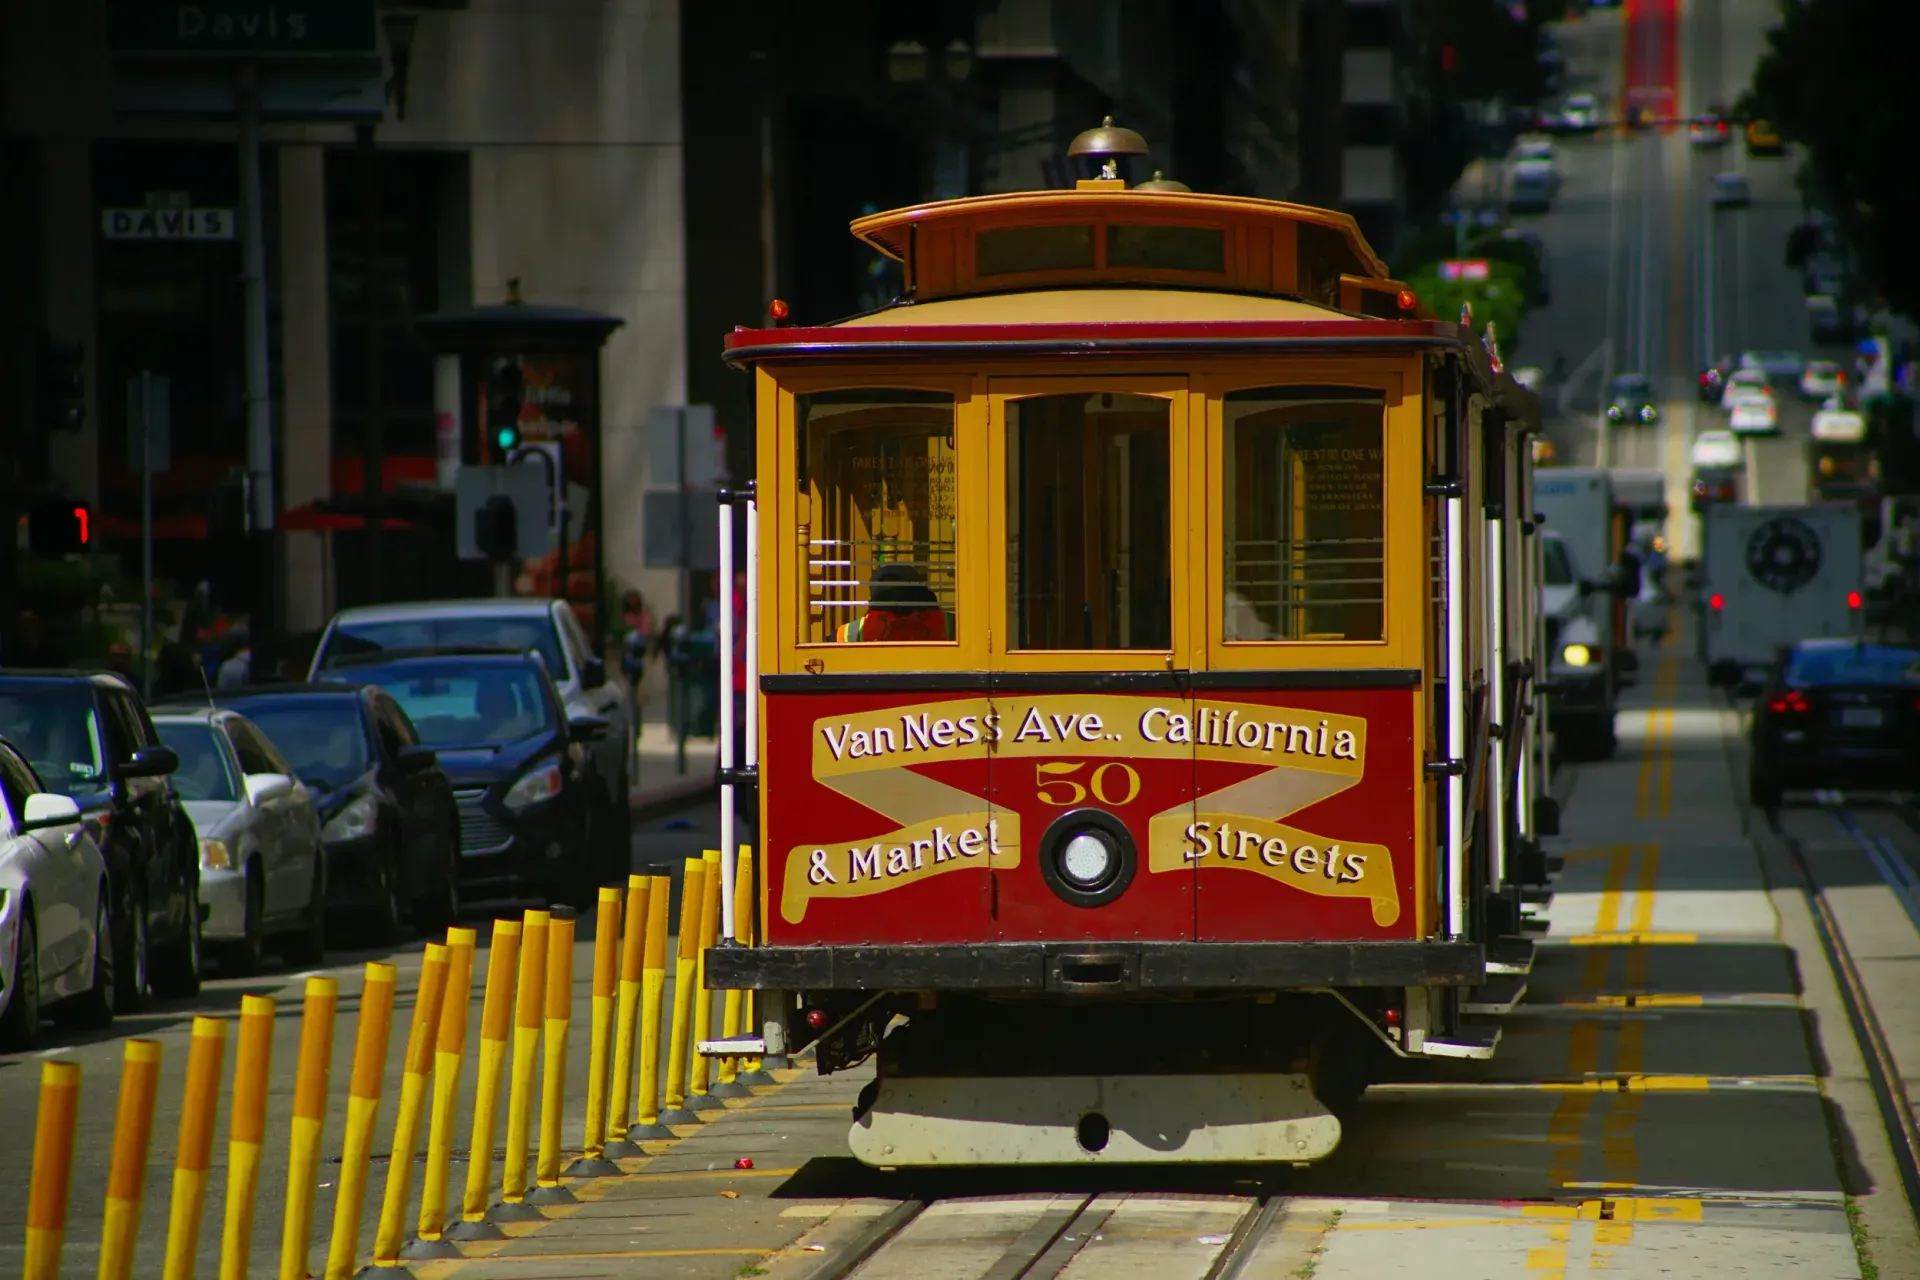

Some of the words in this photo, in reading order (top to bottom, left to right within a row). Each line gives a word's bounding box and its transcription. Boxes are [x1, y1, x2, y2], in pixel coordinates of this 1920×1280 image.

[178, 4, 308, 39] Davis
[113, 211, 222, 234] DAVIS
[822, 723, 896, 761] Van
[900, 711, 1003, 751] Ness
[1138, 707, 1357, 760] California
[1036, 761, 1141, 806] 50
[808, 848, 838, 885] &
[848, 819, 1002, 884] Market
[1183, 821, 1368, 885] Streets
